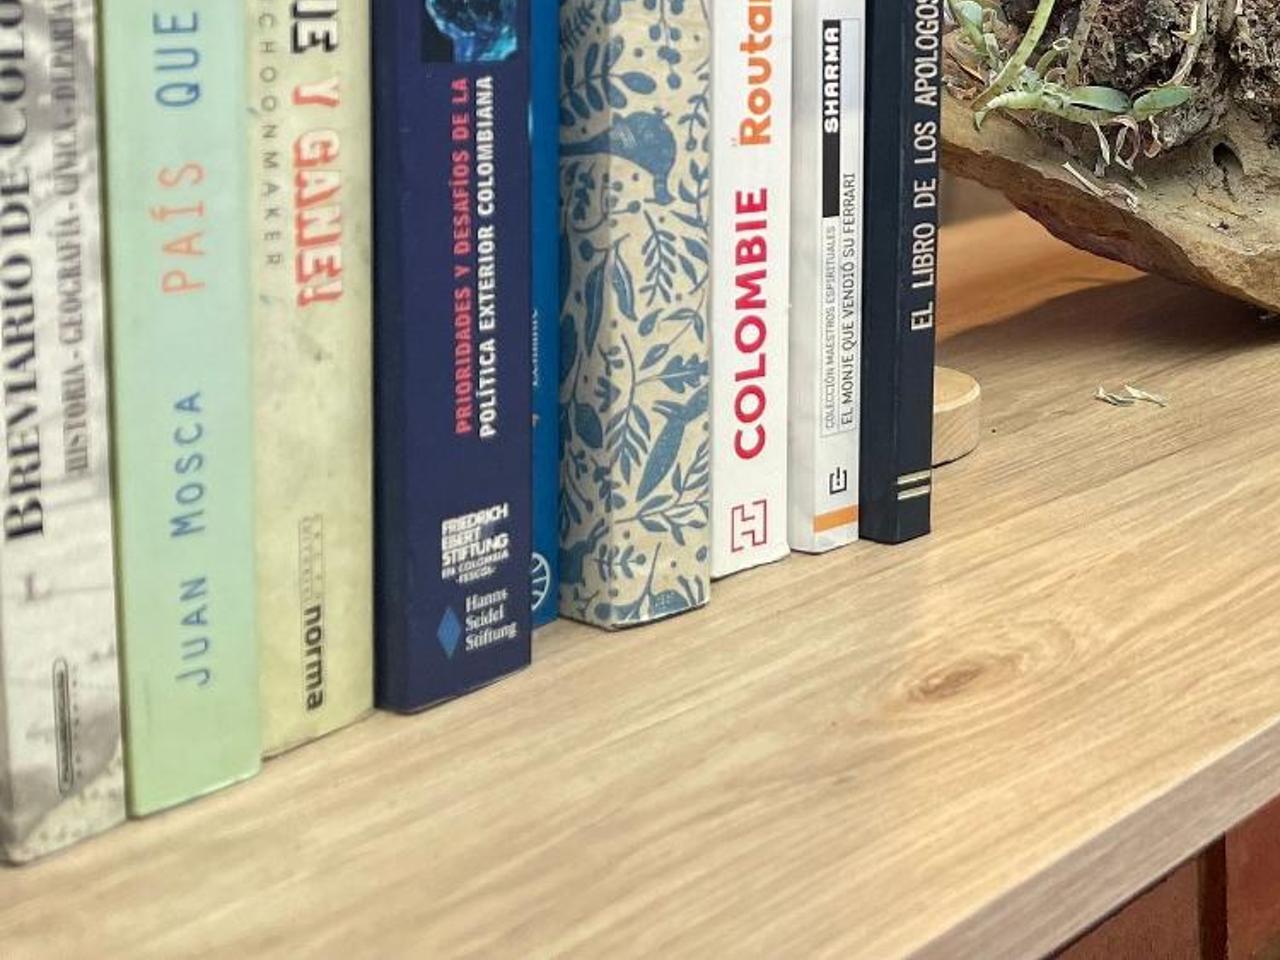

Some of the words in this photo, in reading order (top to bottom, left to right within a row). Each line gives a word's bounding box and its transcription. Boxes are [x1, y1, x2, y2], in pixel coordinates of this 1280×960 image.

[152, 11, 201, 108] QUE
[449, 77, 470, 104] LA
[823, 27, 840, 134] SHARMA
[292, 77, 344, 109] Y
[451, 112, 470, 141] DE
[475, 76, 496, 217] COLOMBIANA
[914, 121, 937, 165] LOS
[0, 167, 32, 240] DE
[293, 127, 345, 308] GANE!
[448, 150, 472, 256] DESAFÍOS
[842, 172, 856, 234] FERRARI
[914, 178, 936, 208] DE
[148, 161, 205, 296] PAÍS
[842, 238, 855, 258] SU
[912, 223, 935, 289] LIBRO
[47, 216, 83, 346] GEOGRAFÍA
[453, 265, 471, 279] Y
[476, 224, 496, 332] EXTERIOR
[825, 225, 837, 304] ESPIRITUALES
[839, 261, 855, 320] VENDIÓ
[733, 188, 767, 461] COLOMBIE
[825, 306, 836, 366] MAESTROS
[841, 321, 858, 352] QUE
[911, 302, 934, 331] EL
[454, 288, 473, 435] PRIORIDADES
[474, 338, 497, 439] POLÍTICA
[841, 354, 854, 405] MONJE
[0, 254, 44, 543] BREVIARIO
[60, 364, 88, 474] HISTORIA
[823, 368, 836, 429] COLECCIÓN
[841, 408, 854, 426] EL
[168, 392, 206, 539] MOSCA
[441, 533, 510, 568] STIFTUNG
[175, 577, 211, 687] JUAN
[466, 604, 505, 633] Seidel
[466, 622, 518, 652] Stiftung
[302, 606, 324, 712] norma
